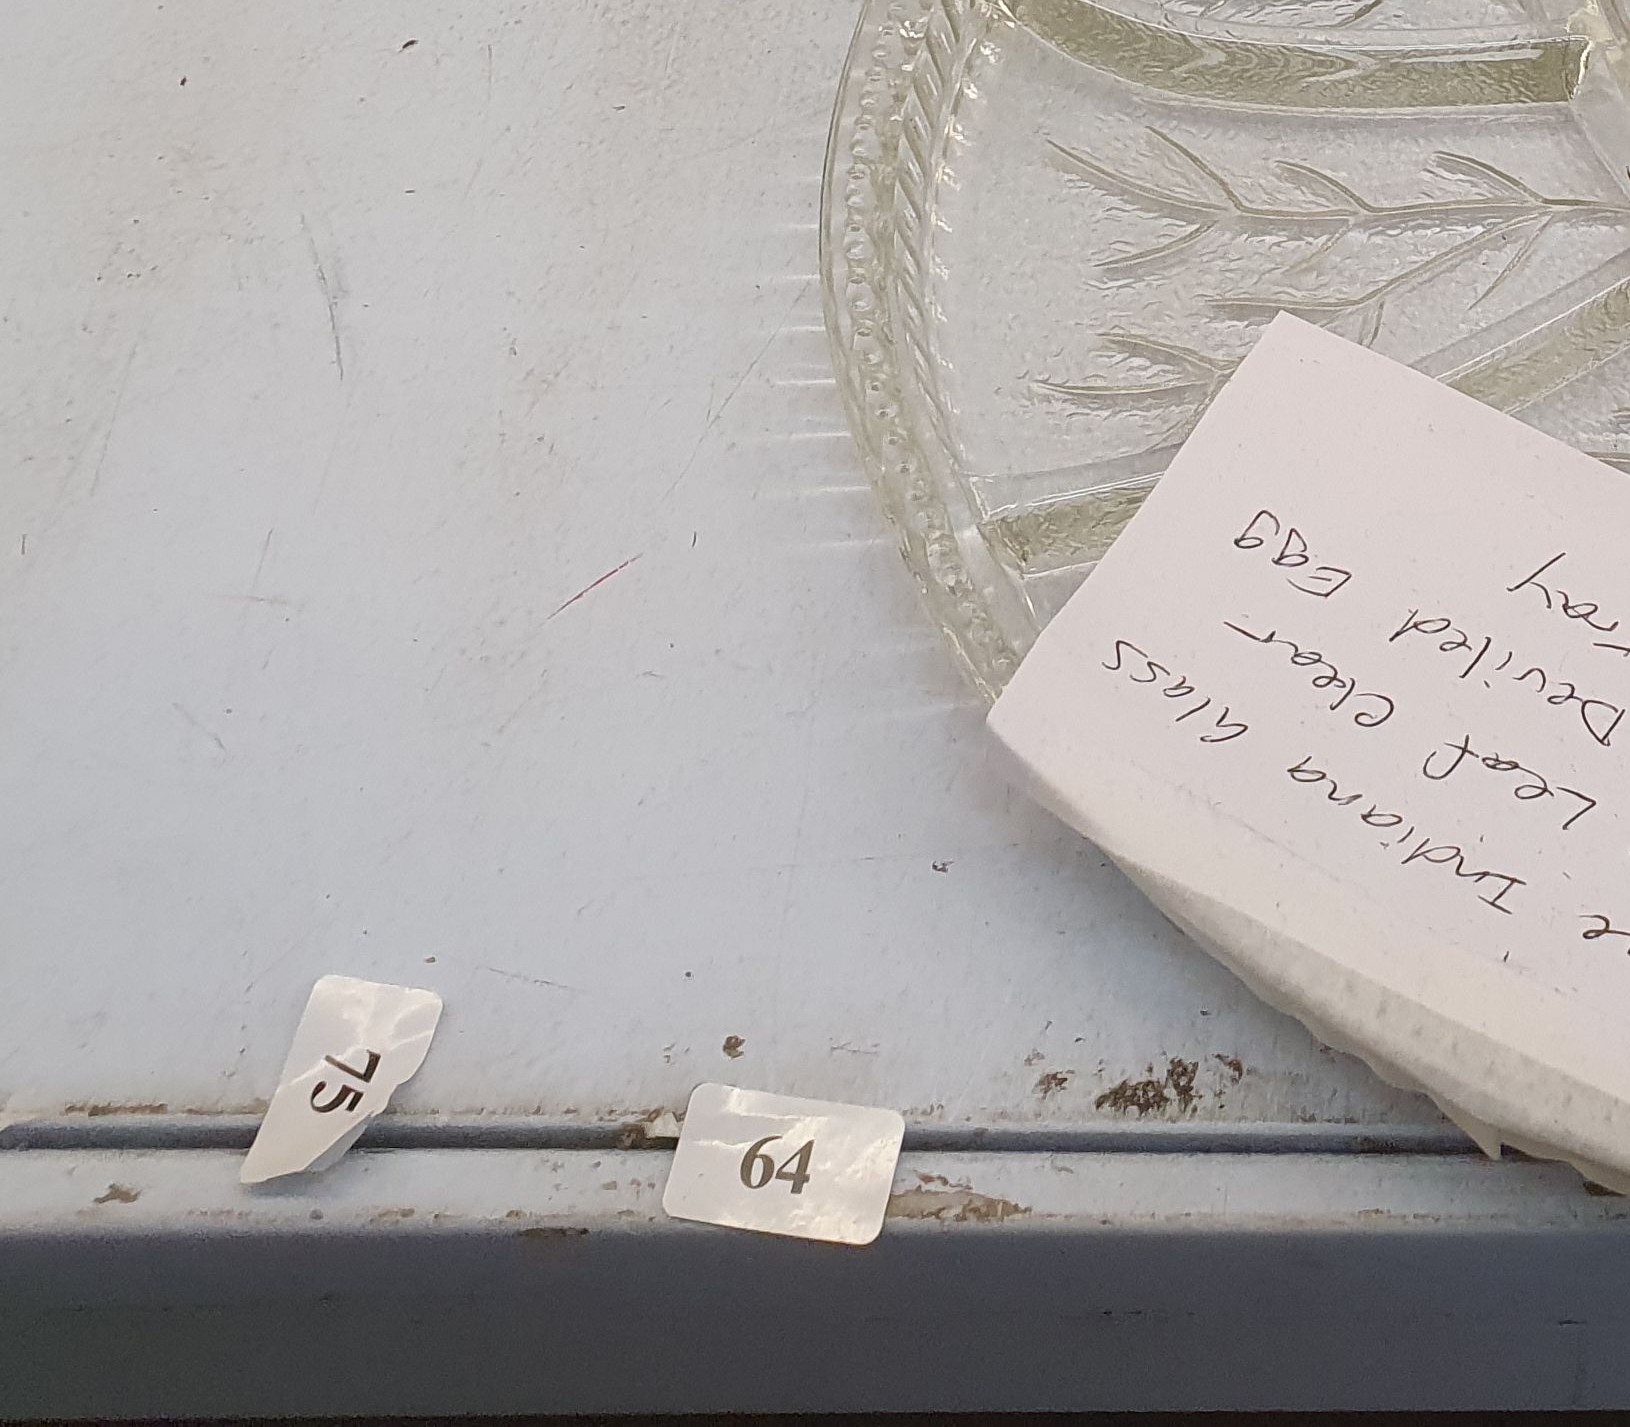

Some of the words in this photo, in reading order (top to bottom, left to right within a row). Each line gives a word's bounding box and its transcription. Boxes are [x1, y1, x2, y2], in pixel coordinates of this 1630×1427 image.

[1233, 509, 1353, 599] Egg
[1101, 639, 1249, 744] Glass
[1388, 608, 1627, 748] Deviled
[1422, 733, 1598, 831] Leaf
[1286, 755, 1528, 915] Indiana
[310, 1049, 381, 1114] 75
[738, 1135, 815, 1195] 64
